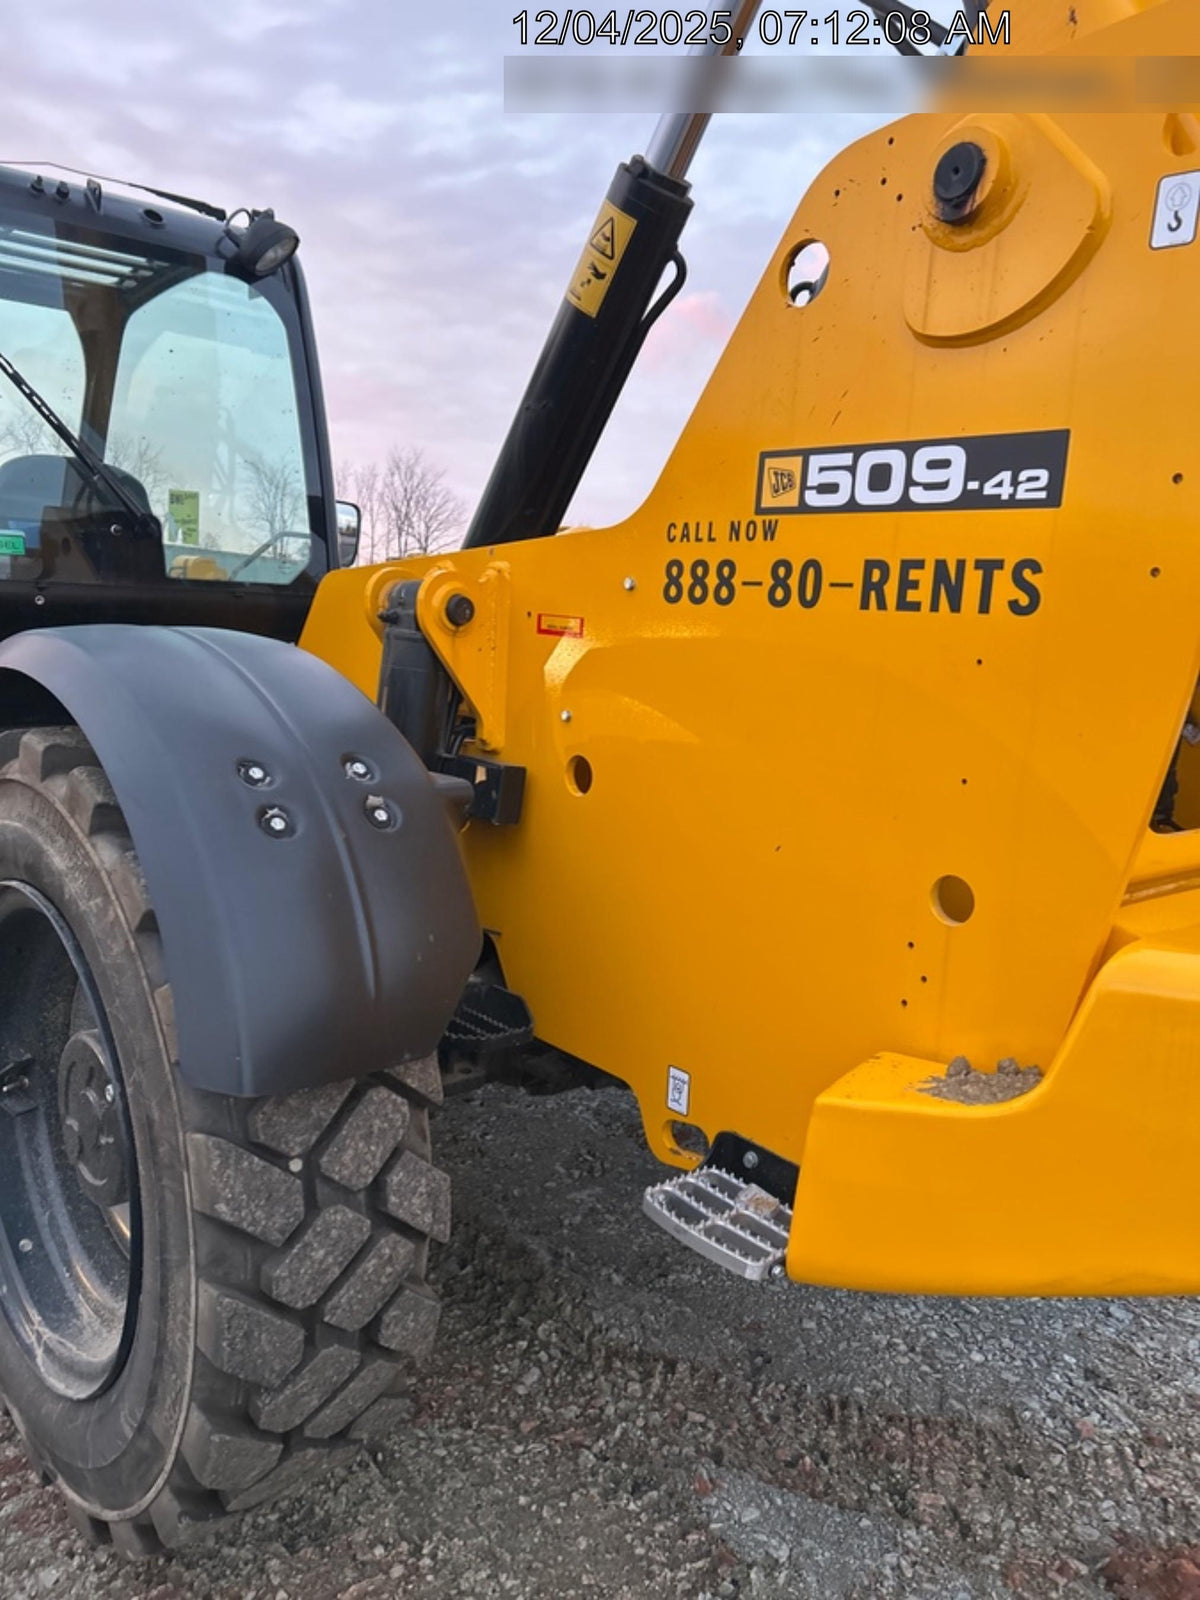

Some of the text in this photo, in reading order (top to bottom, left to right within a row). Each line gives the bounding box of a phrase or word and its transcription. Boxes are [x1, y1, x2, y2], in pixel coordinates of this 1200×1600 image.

[769, 444, 1050, 508] JCB 509-42
[667, 519, 779, 543] CALL NOW
[663, 558, 1044, 617] 888-80-RENTS
